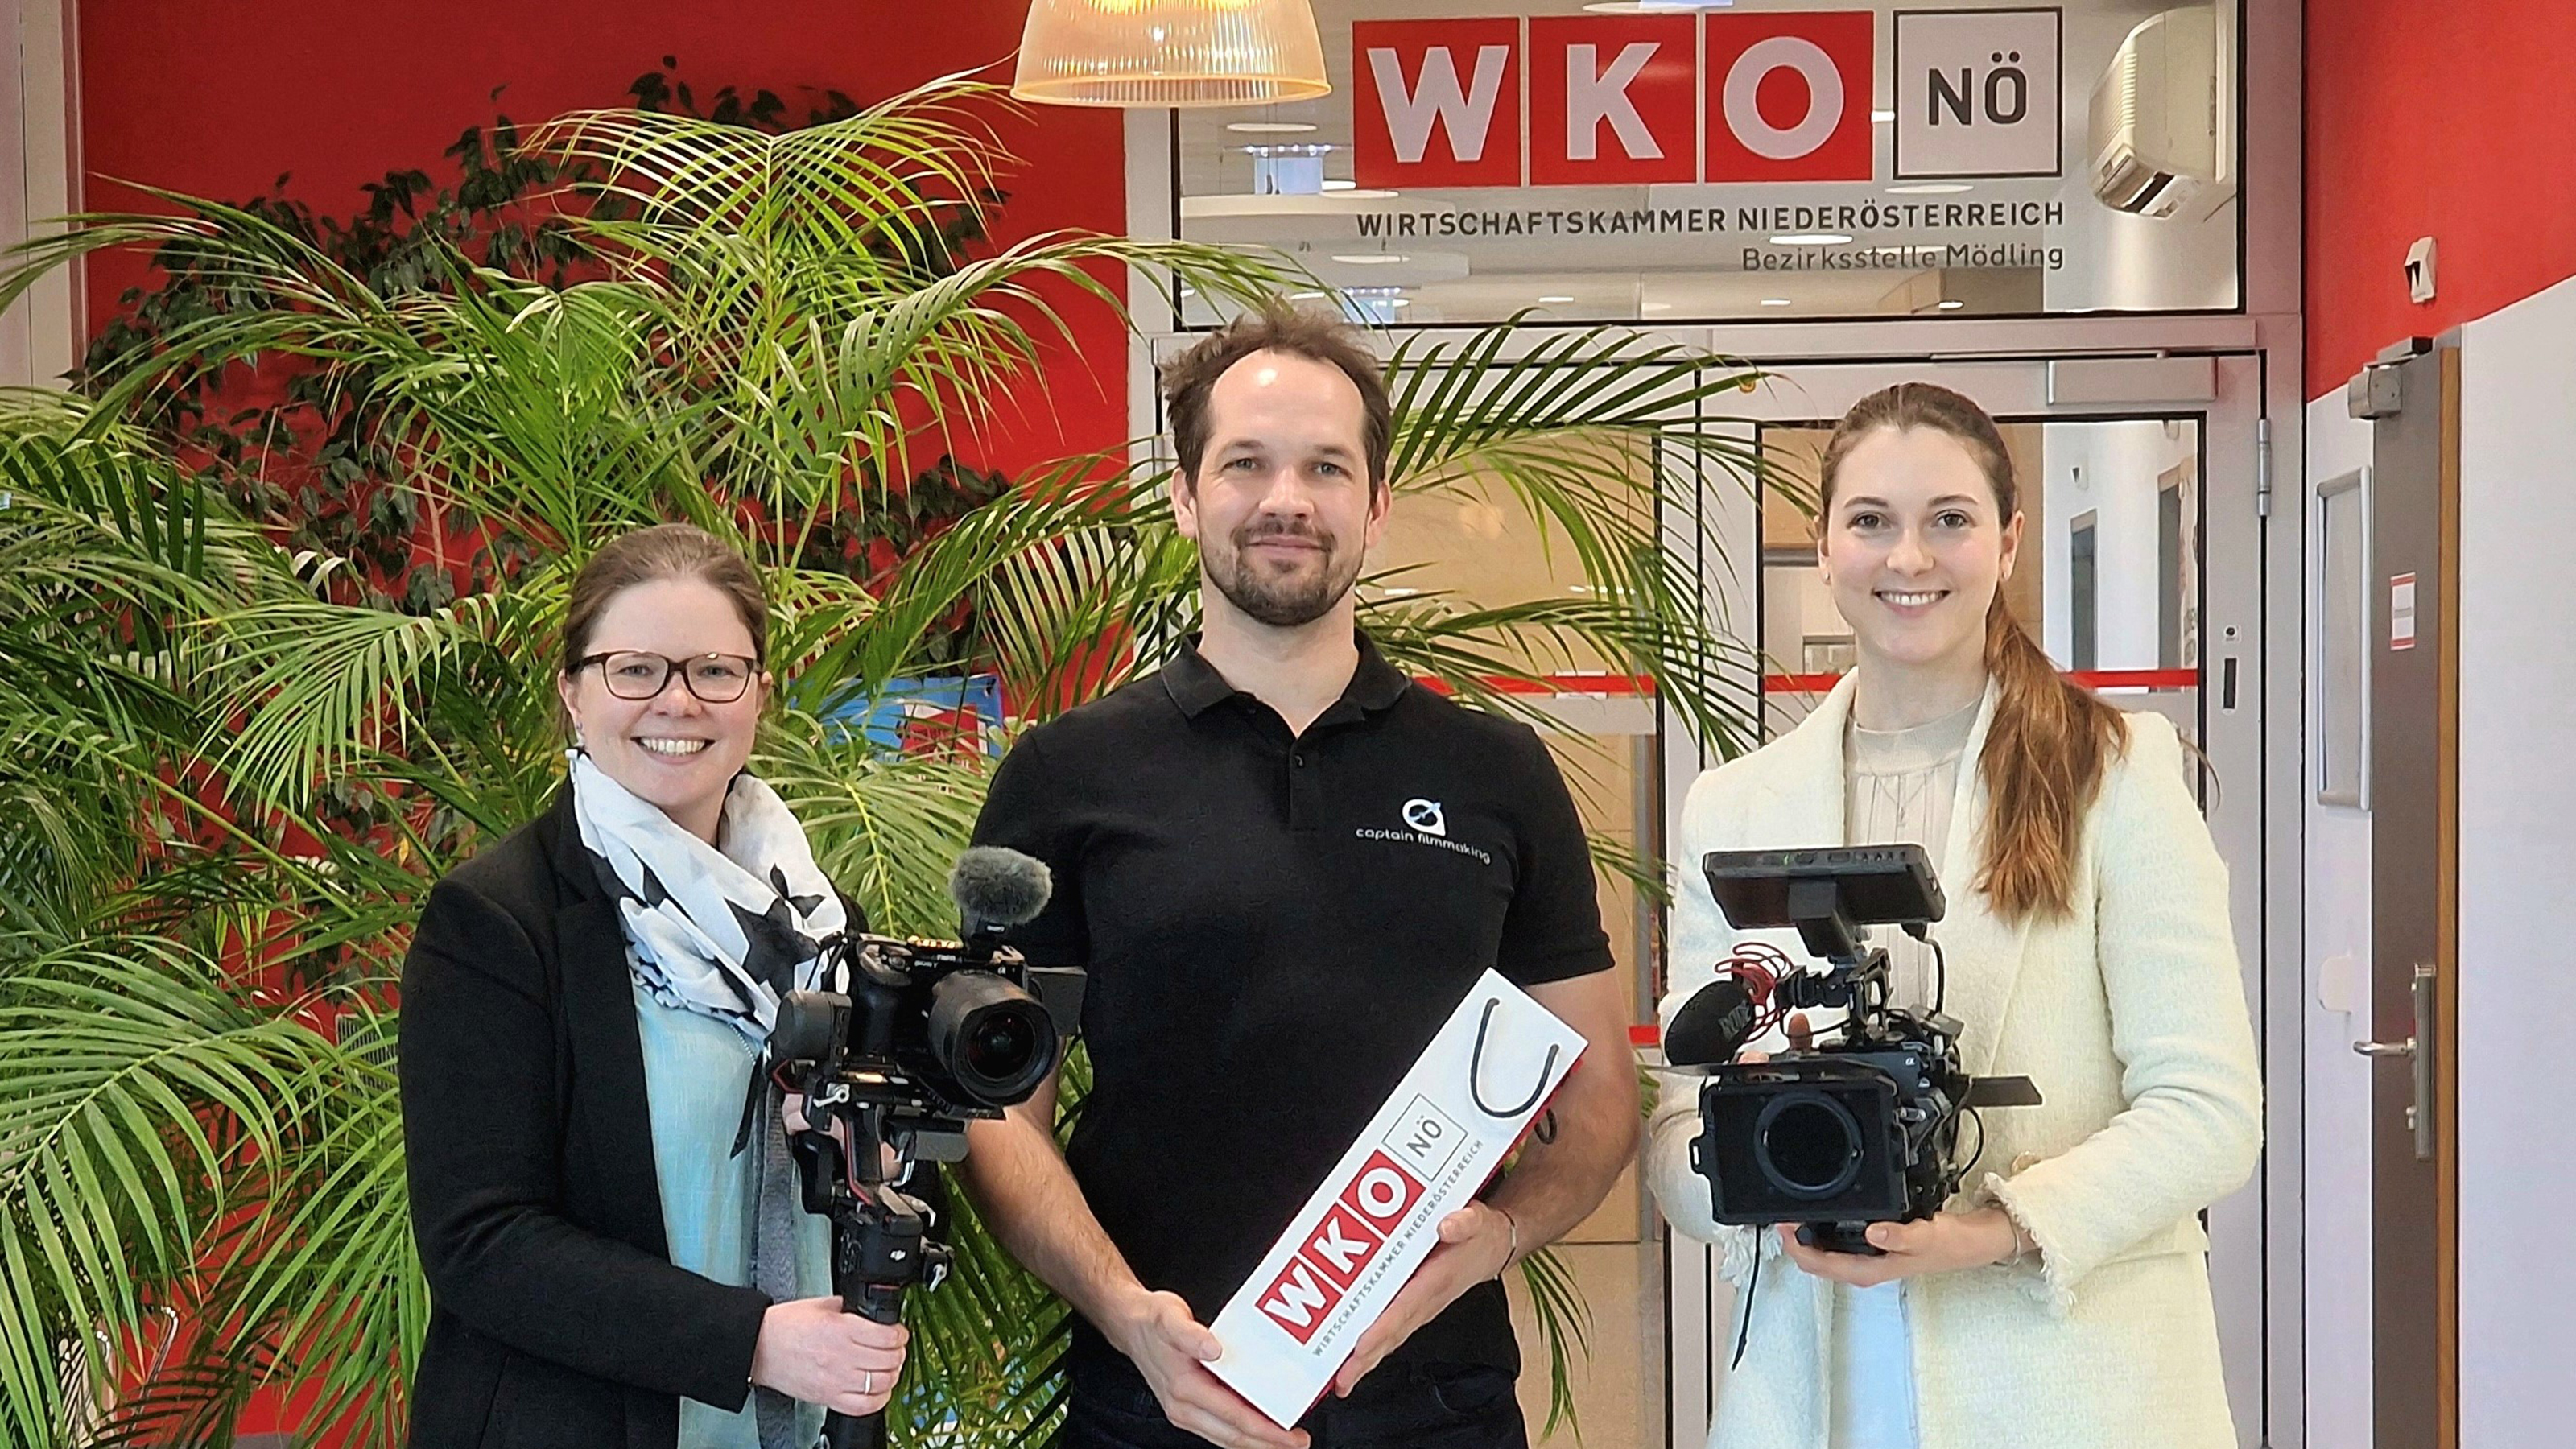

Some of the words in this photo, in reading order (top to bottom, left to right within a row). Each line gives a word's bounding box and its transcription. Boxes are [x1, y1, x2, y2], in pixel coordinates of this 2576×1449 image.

[1367, 35, 1844, 163] WKO
[1928, 52, 2027, 126] NÖ
[1356, 208, 1726, 237] WIRTSCHAFTSKAMMER
[1737, 198, 2063, 232] NIEDERÖSTERREICH
[1742, 245, 1937, 272] Bezirksstelle
[1946, 242, 2064, 270] Mödling
[1356, 828, 1414, 843] captain
[1417, 832, 1491, 865] filmmaking
[1263, 1167, 1406, 1328] WKO
[1406, 1114, 1443, 1158] NÖ
[1312, 1240, 1406, 1356] WIRTSCHAFTSKAMMER
[1404, 1140, 1484, 1241] NIEDERÖSTERREICH
